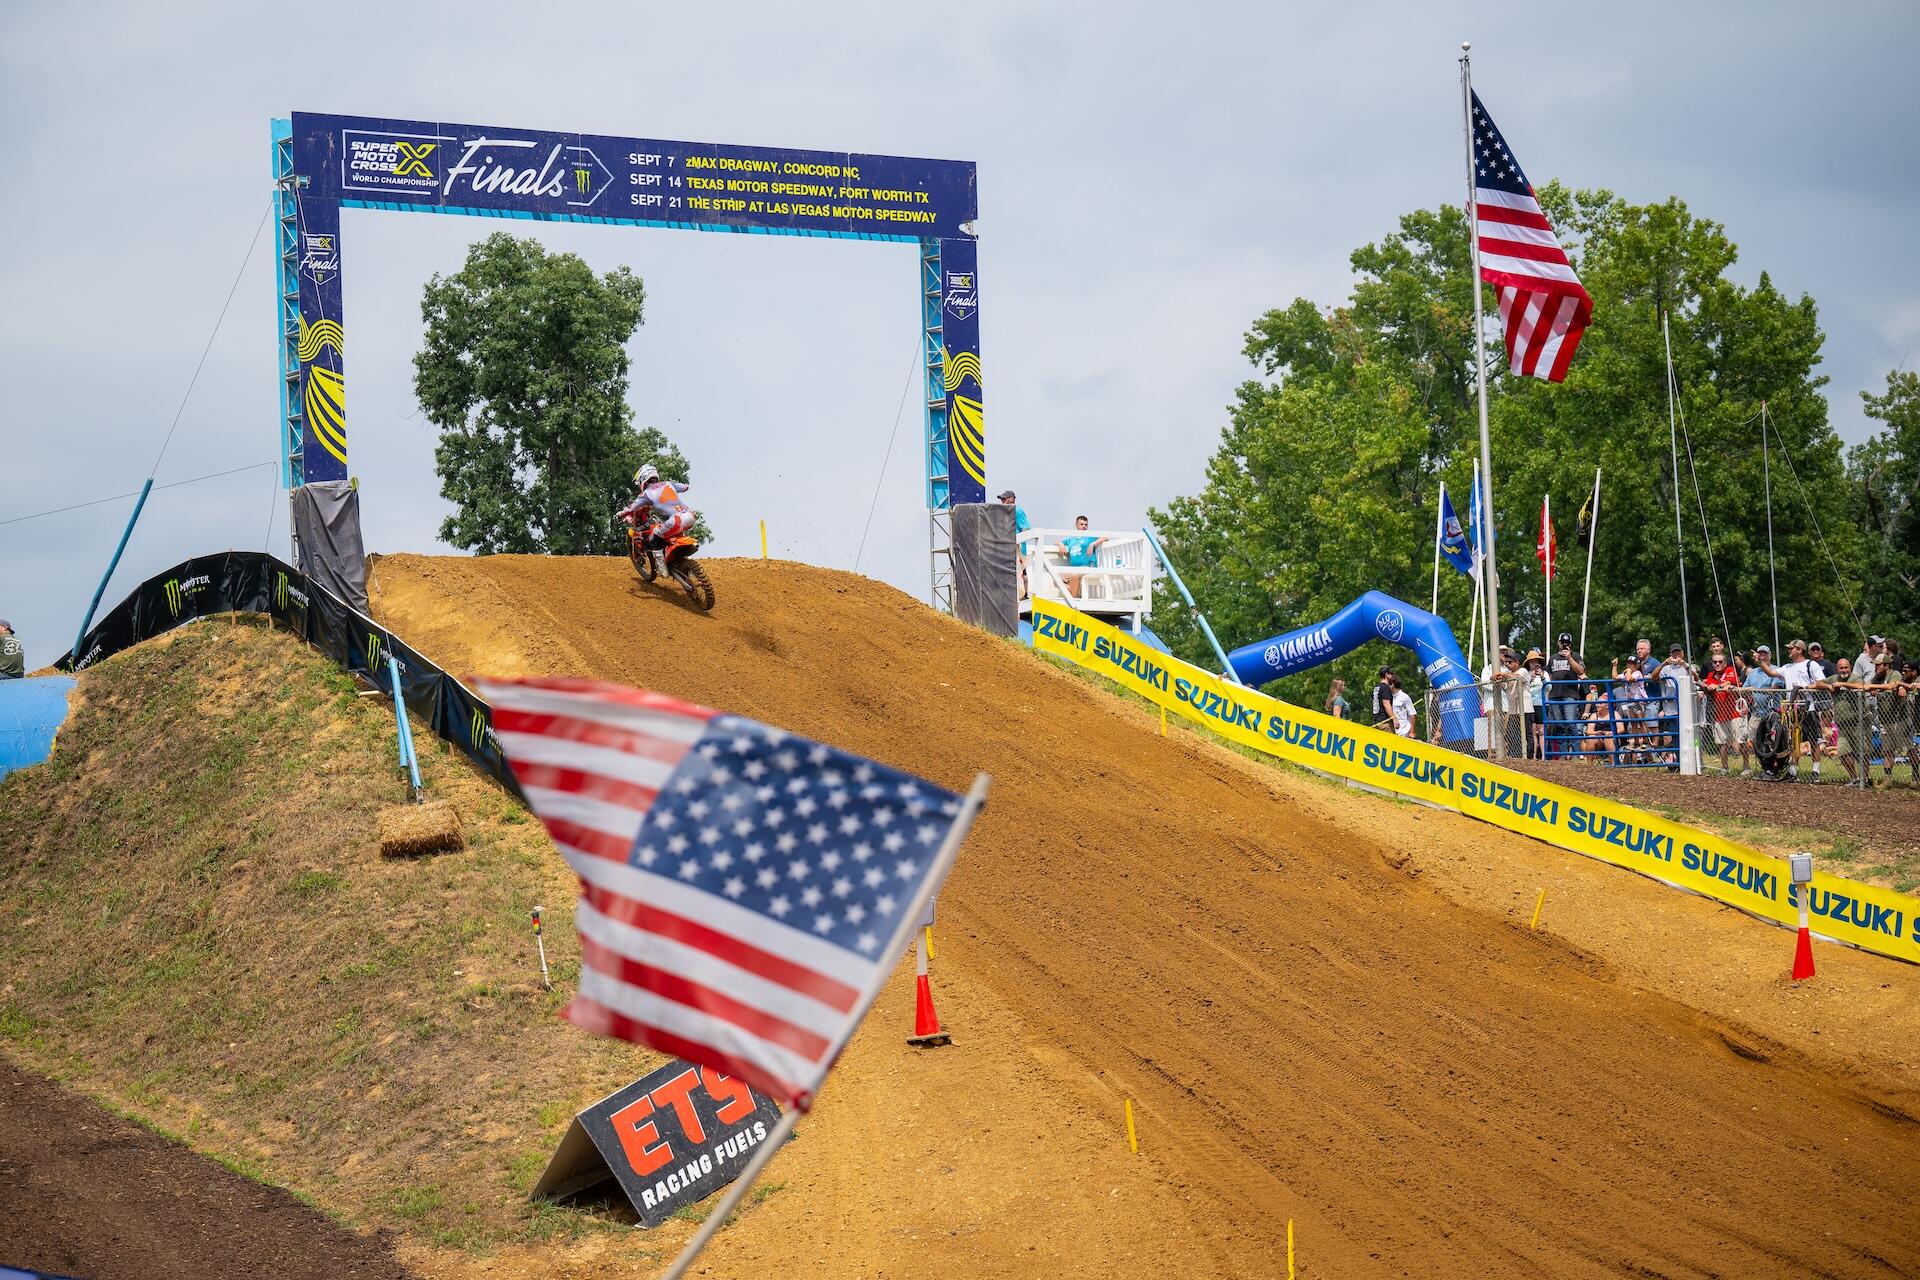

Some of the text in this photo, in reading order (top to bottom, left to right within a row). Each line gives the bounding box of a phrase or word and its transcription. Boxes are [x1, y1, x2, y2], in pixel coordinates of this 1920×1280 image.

[350, 141, 399, 153] SUPER
[353, 151, 398, 163] MOTO
[392, 141, 437, 178] X
[350, 160, 398, 172] CROSS
[443, 136, 566, 198] Finals
[629, 153, 859, 179] SEPT 7 zMAX DRAGWAY, CONCORD NC
[352, 174, 439, 187] WORLD CHAMPIONSHIP
[630, 173, 929, 203] SEPT 14 TEXAS MOTOR SPEEDWAY, FORT WORTH TX
[630, 194, 937, 223] SEPT 21 THE STRIP AT LAS VEGAS MOTOR SPEEDWAY
[299, 251, 339, 271] Finals
[943, 289, 978, 307] Finals
[1280, 626, 1333, 661] YAMAHA
[1275, 646, 1334, 670] RACING
[1093, 636, 1169, 692] SUZUKI
[1175, 677, 1262, 732] SUZUKI
[1267, 716, 1356, 762] SUZUKI
[1363, 744, 1454, 791] SUZUKI
[1461, 772, 1559, 826] SUZUKI
[1567, 806, 1674, 863] SUZUKI
[1681, 843, 1778, 902] SUZUKI
[610, 1063, 757, 1177] ETS
[714, 1120, 767, 1166] FUELS
